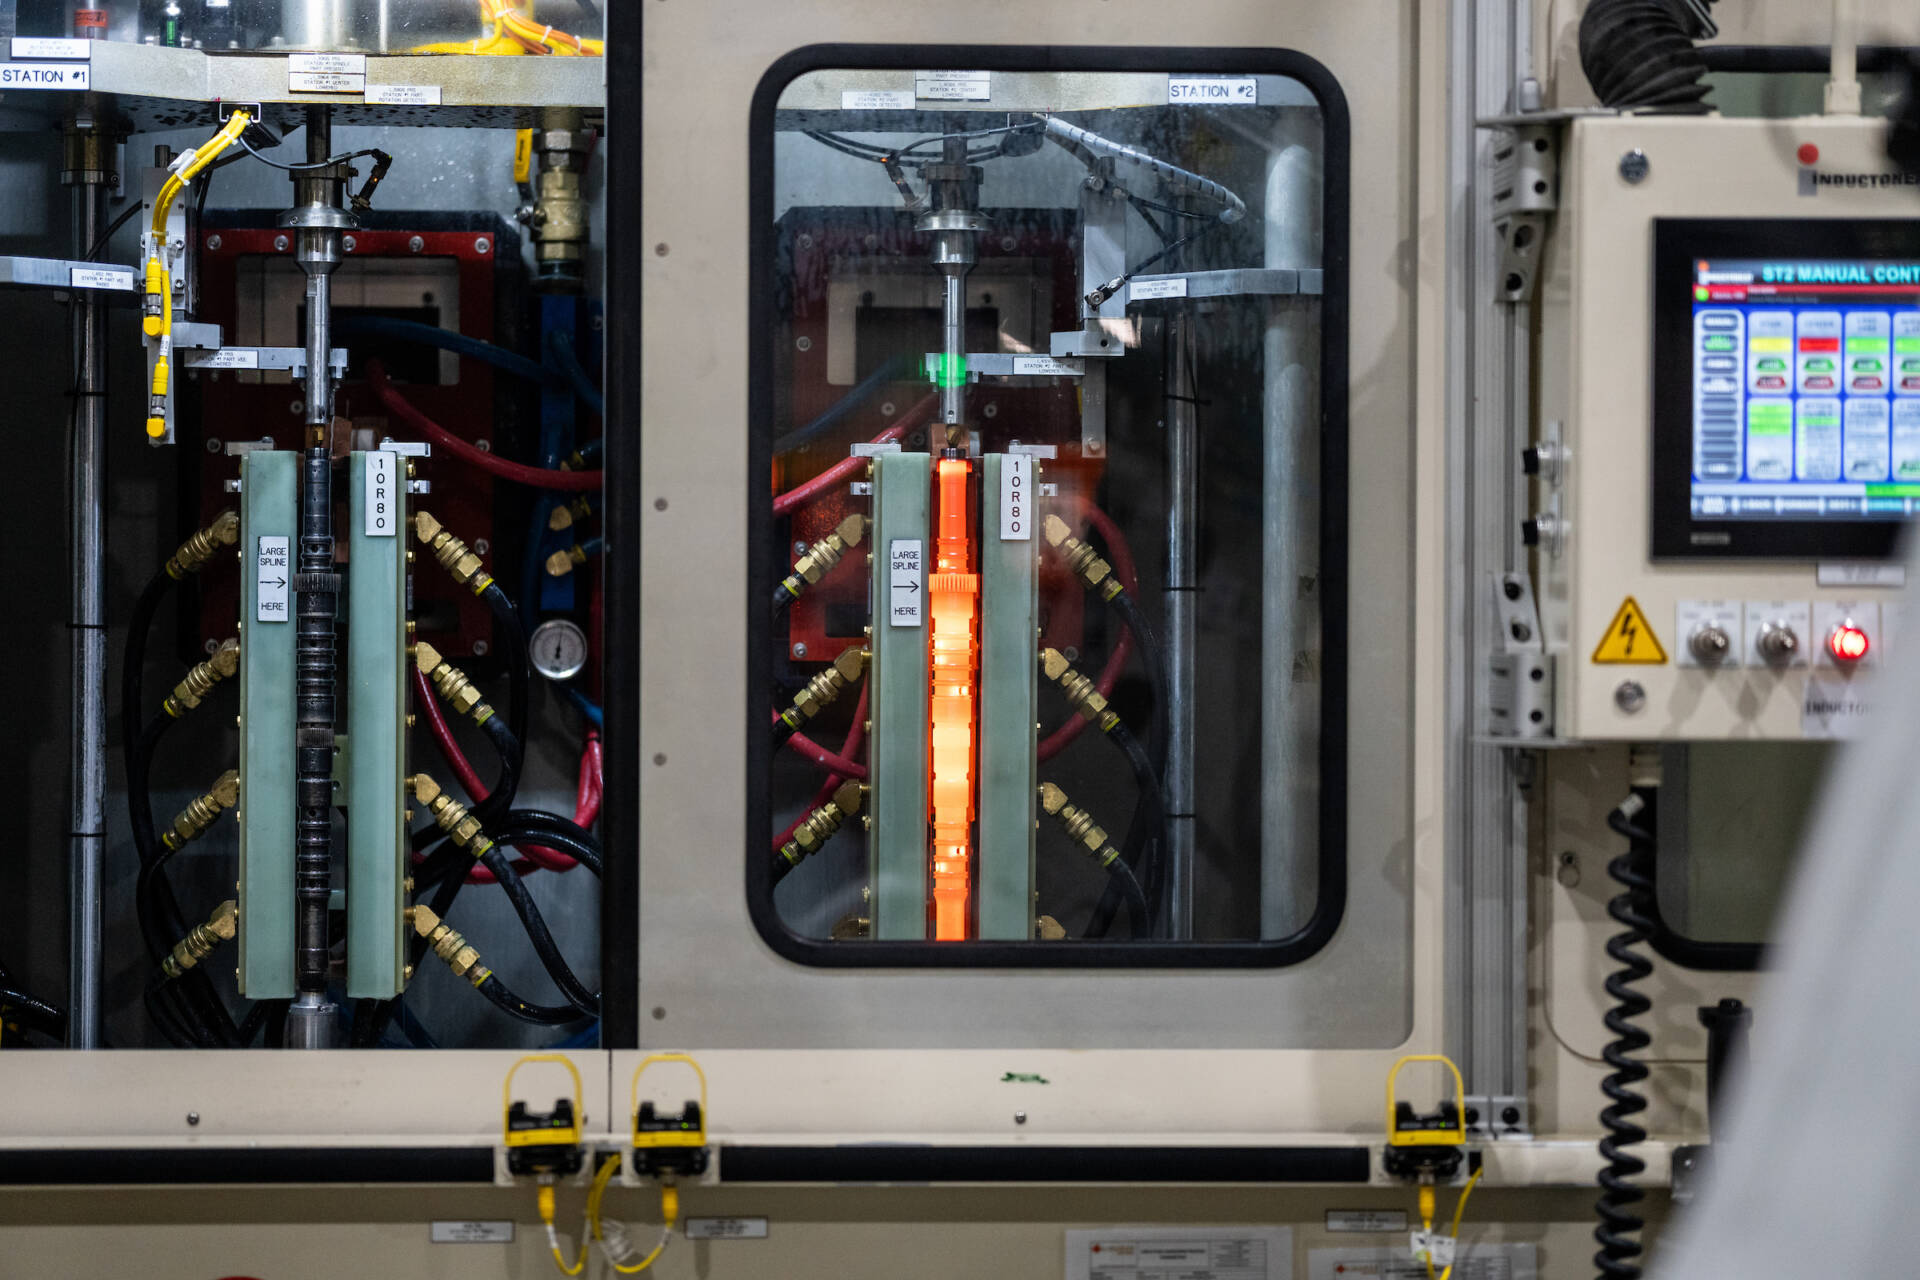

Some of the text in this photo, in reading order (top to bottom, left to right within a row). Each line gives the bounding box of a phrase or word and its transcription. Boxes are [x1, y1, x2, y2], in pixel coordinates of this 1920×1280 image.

[3, 69, 86, 83] STATION #1
[1170, 84, 1255, 97] STATION #2
[1762, 265, 1795, 282] ST2
[1797, 265, 1870, 283] MANUAL
[1873, 265, 1920, 283] CONT
[375, 459, 386, 529] 10R80
[1011, 461, 1021, 533] 10R80
[260, 547, 287, 556] LARGE
[892, 551, 920, 559] LARGE
[260, 558, 287, 567] SPLINE
[892, 562, 920, 570] SPLINE
[261, 602, 285, 611] HERE
[895, 607, 918, 615] HERE
